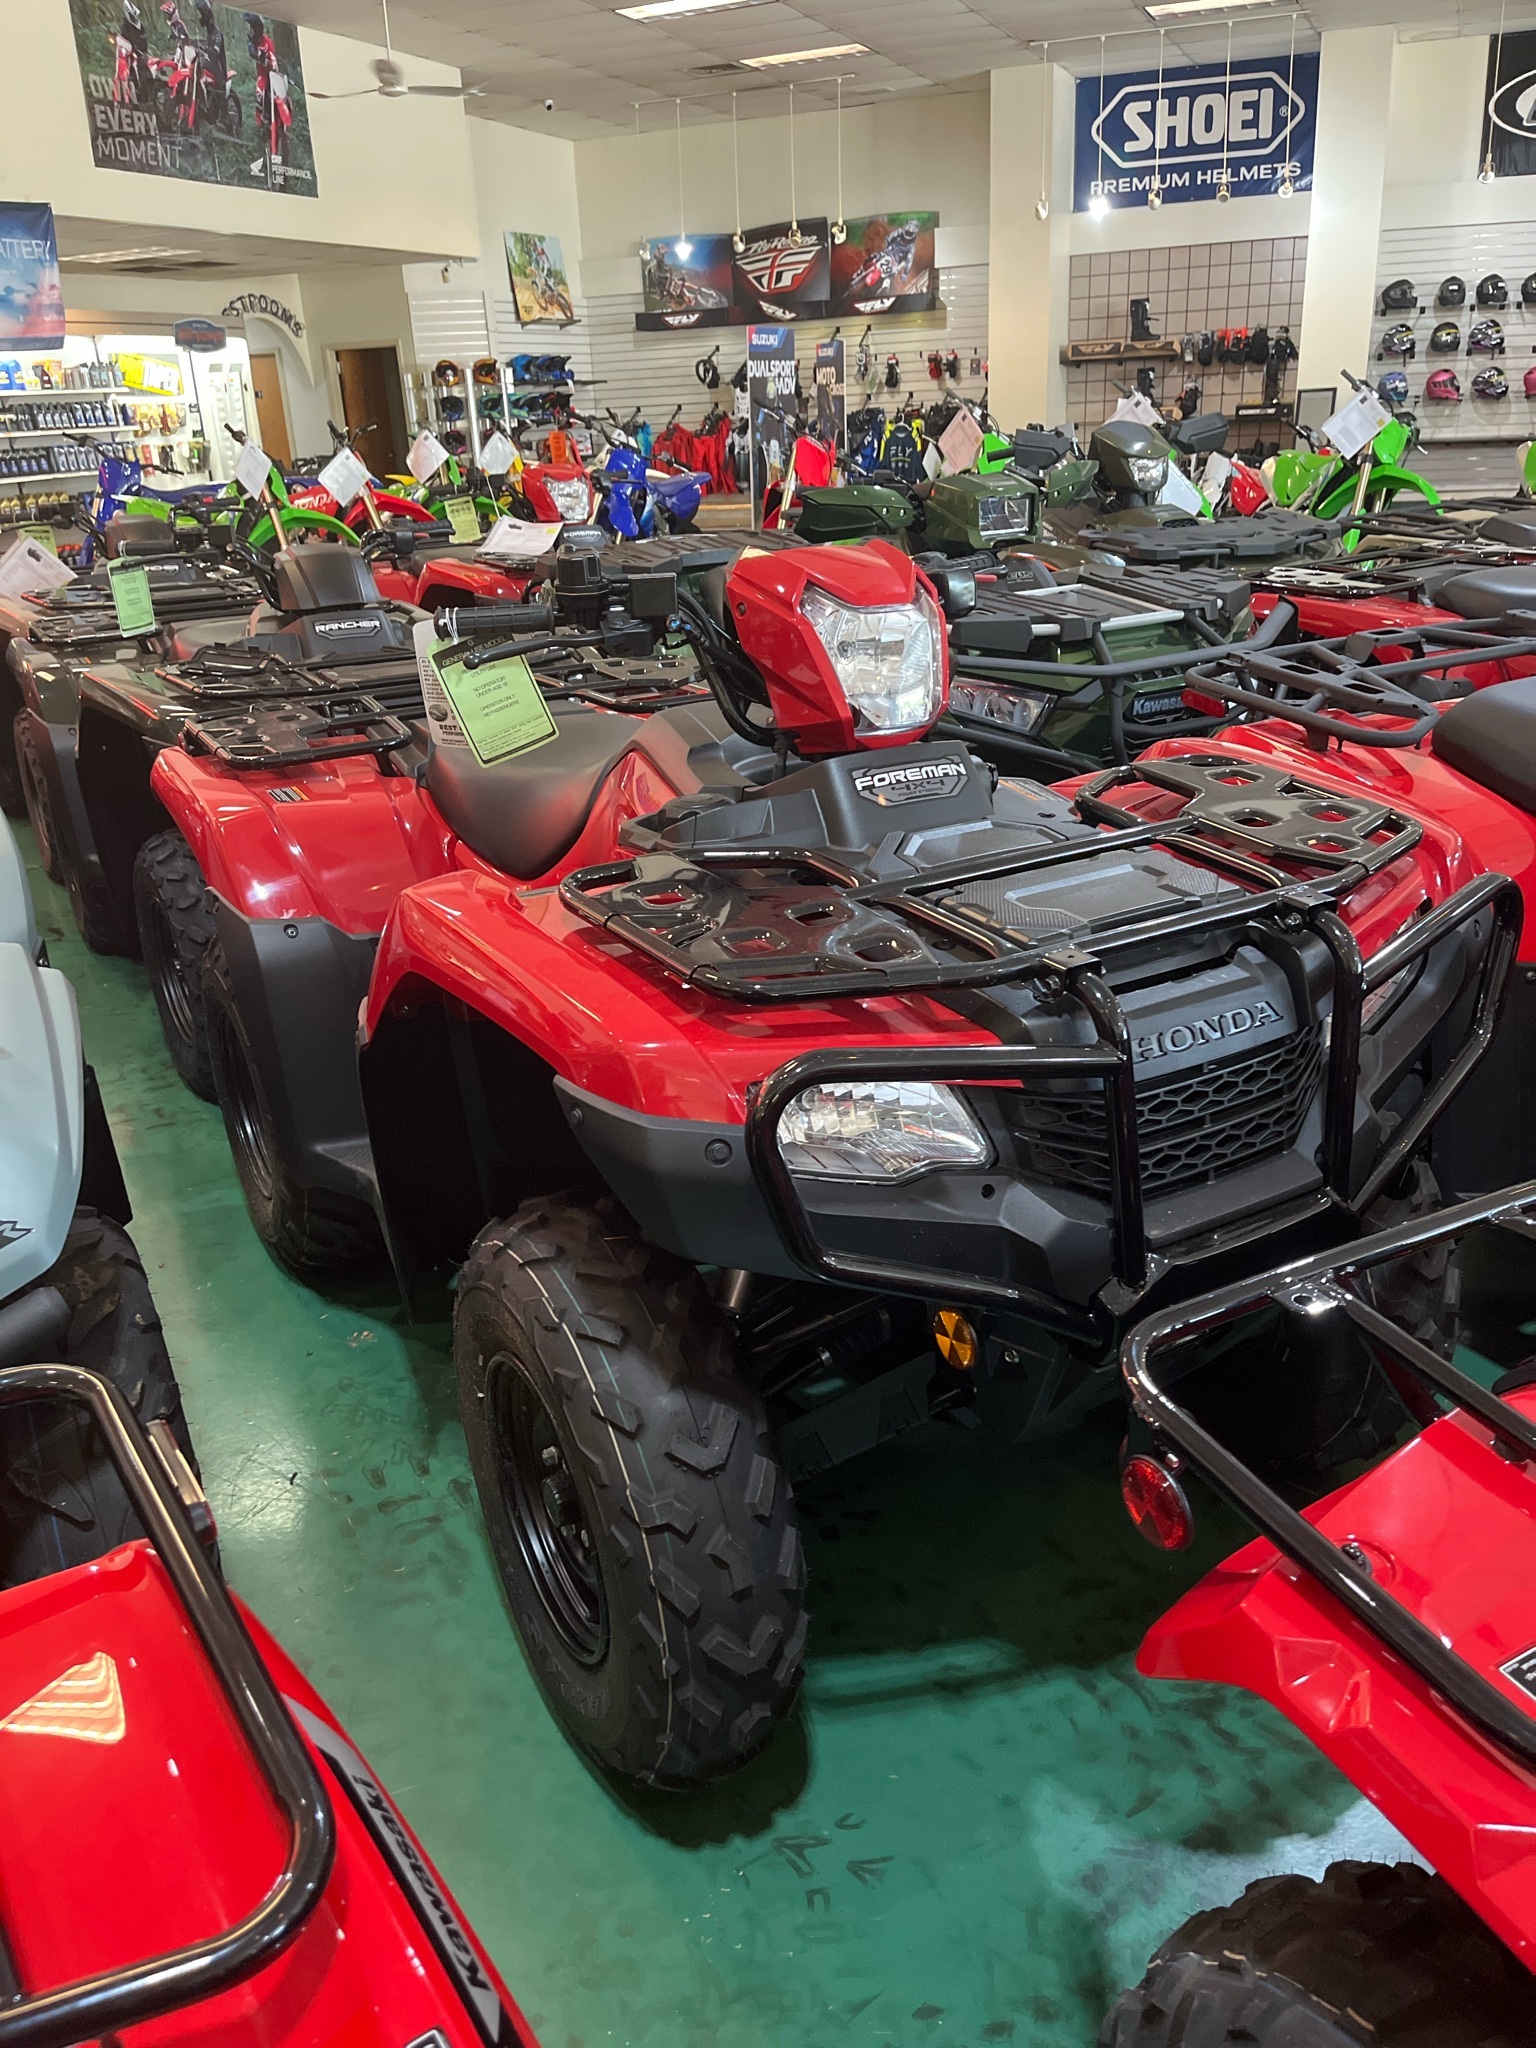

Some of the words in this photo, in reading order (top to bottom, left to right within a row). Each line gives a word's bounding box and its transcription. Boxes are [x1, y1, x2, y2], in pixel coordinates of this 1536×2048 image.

[88, 74, 138, 104] OWN
[94, 104, 158, 134] EVERY
[1123, 88, 1274, 152] SHOEI
[96, 134, 182, 169] MOMENT
[272, 165, 312, 180] PERFORMANCE
[272, 174, 285, 185] LINE
[1091, 172, 1189, 195] PREMIUM
[1196, 161, 1301, 185] HELMETS
[880, 259, 892, 275] 29
[664, 313, 700, 326] FLY
[752, 333, 778, 345] SUZUKI
[816, 367, 836, 385] MOTO
[890, 446, 913, 457] FLY
[315, 620, 380, 633] RANCHER
[484, 636, 505, 649] MODEL
[1133, 696, 1184, 716] Kawasa
[854, 763, 967, 791] FOREMAN
[1132, 1000, 1284, 1064] HONDA
[352, 1775, 493, 1992] Kawasaki
